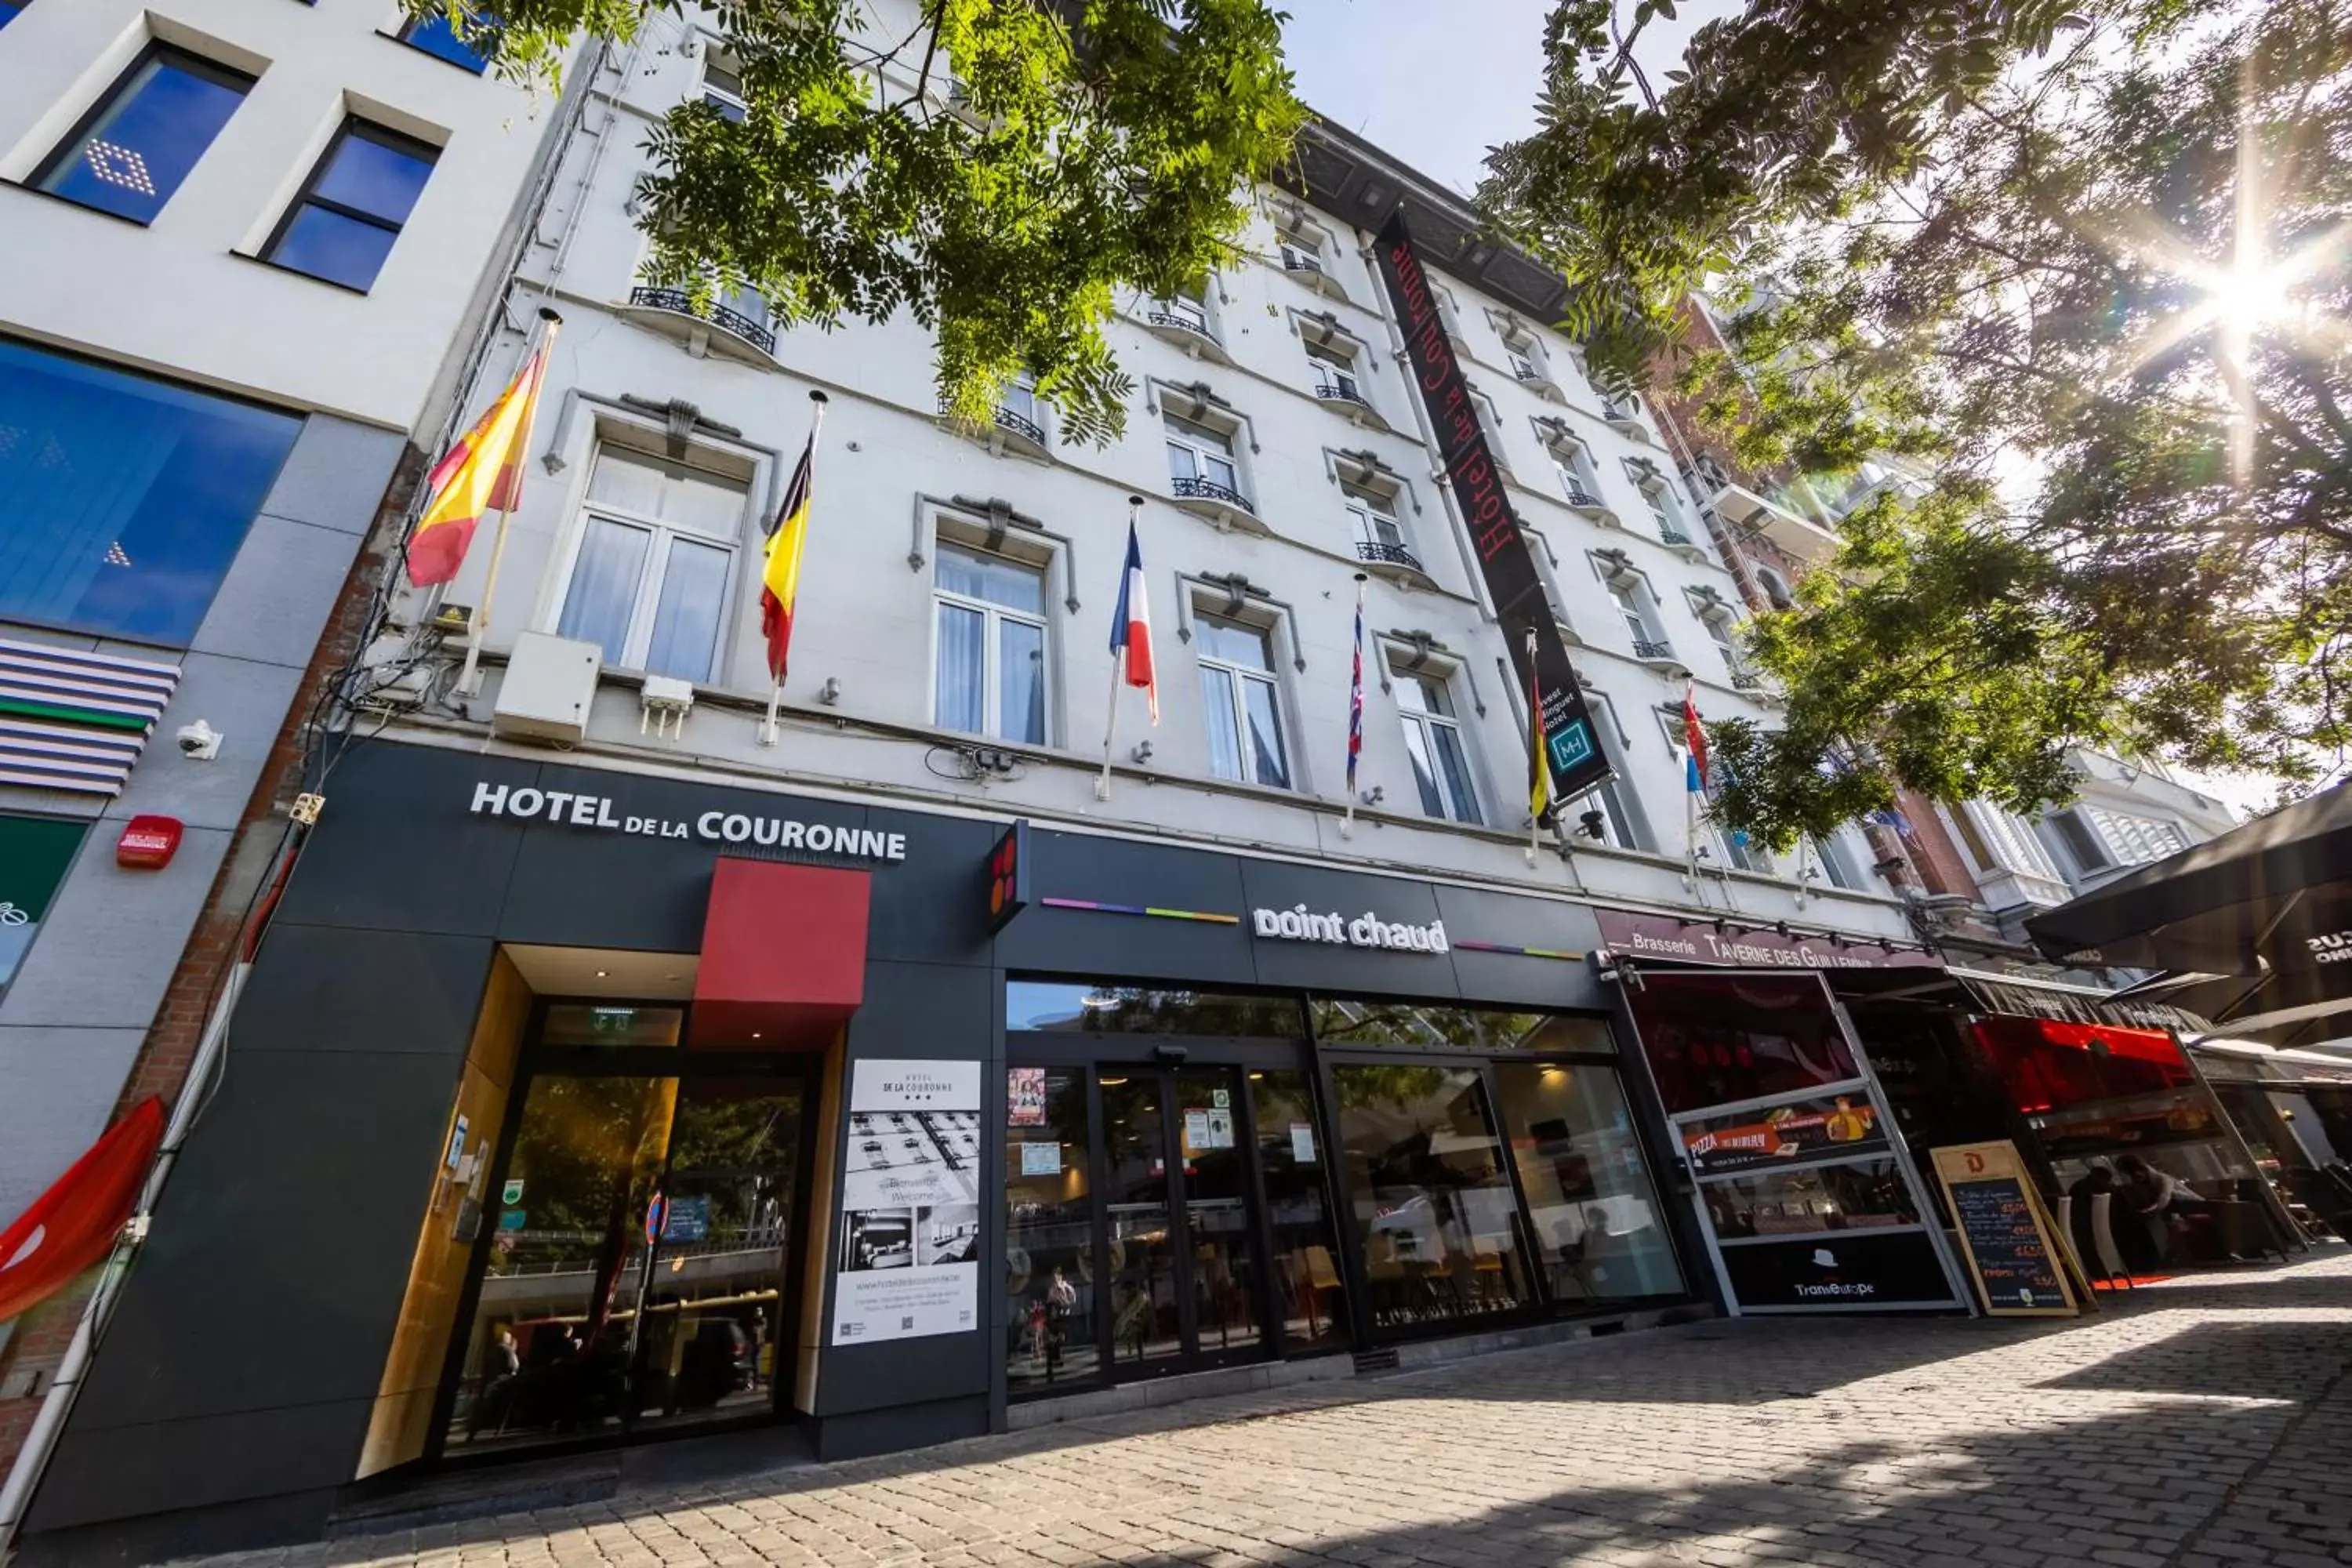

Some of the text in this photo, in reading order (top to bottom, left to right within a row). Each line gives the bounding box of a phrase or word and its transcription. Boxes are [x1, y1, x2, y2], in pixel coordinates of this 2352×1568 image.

[1392, 241, 1513, 561] Hôtel de la Couronne
[470, 782, 906, 860] HOTEL DE LA COURONNE
[1348, 911, 1450, 954] chaud
[1632, 933, 1697, 955] Brasserie
[1704, 934, 1775, 964] TAVERNE
[1773, 948, 1802, 967] DES
[1690, 1132, 1718, 1158] PIZZA
